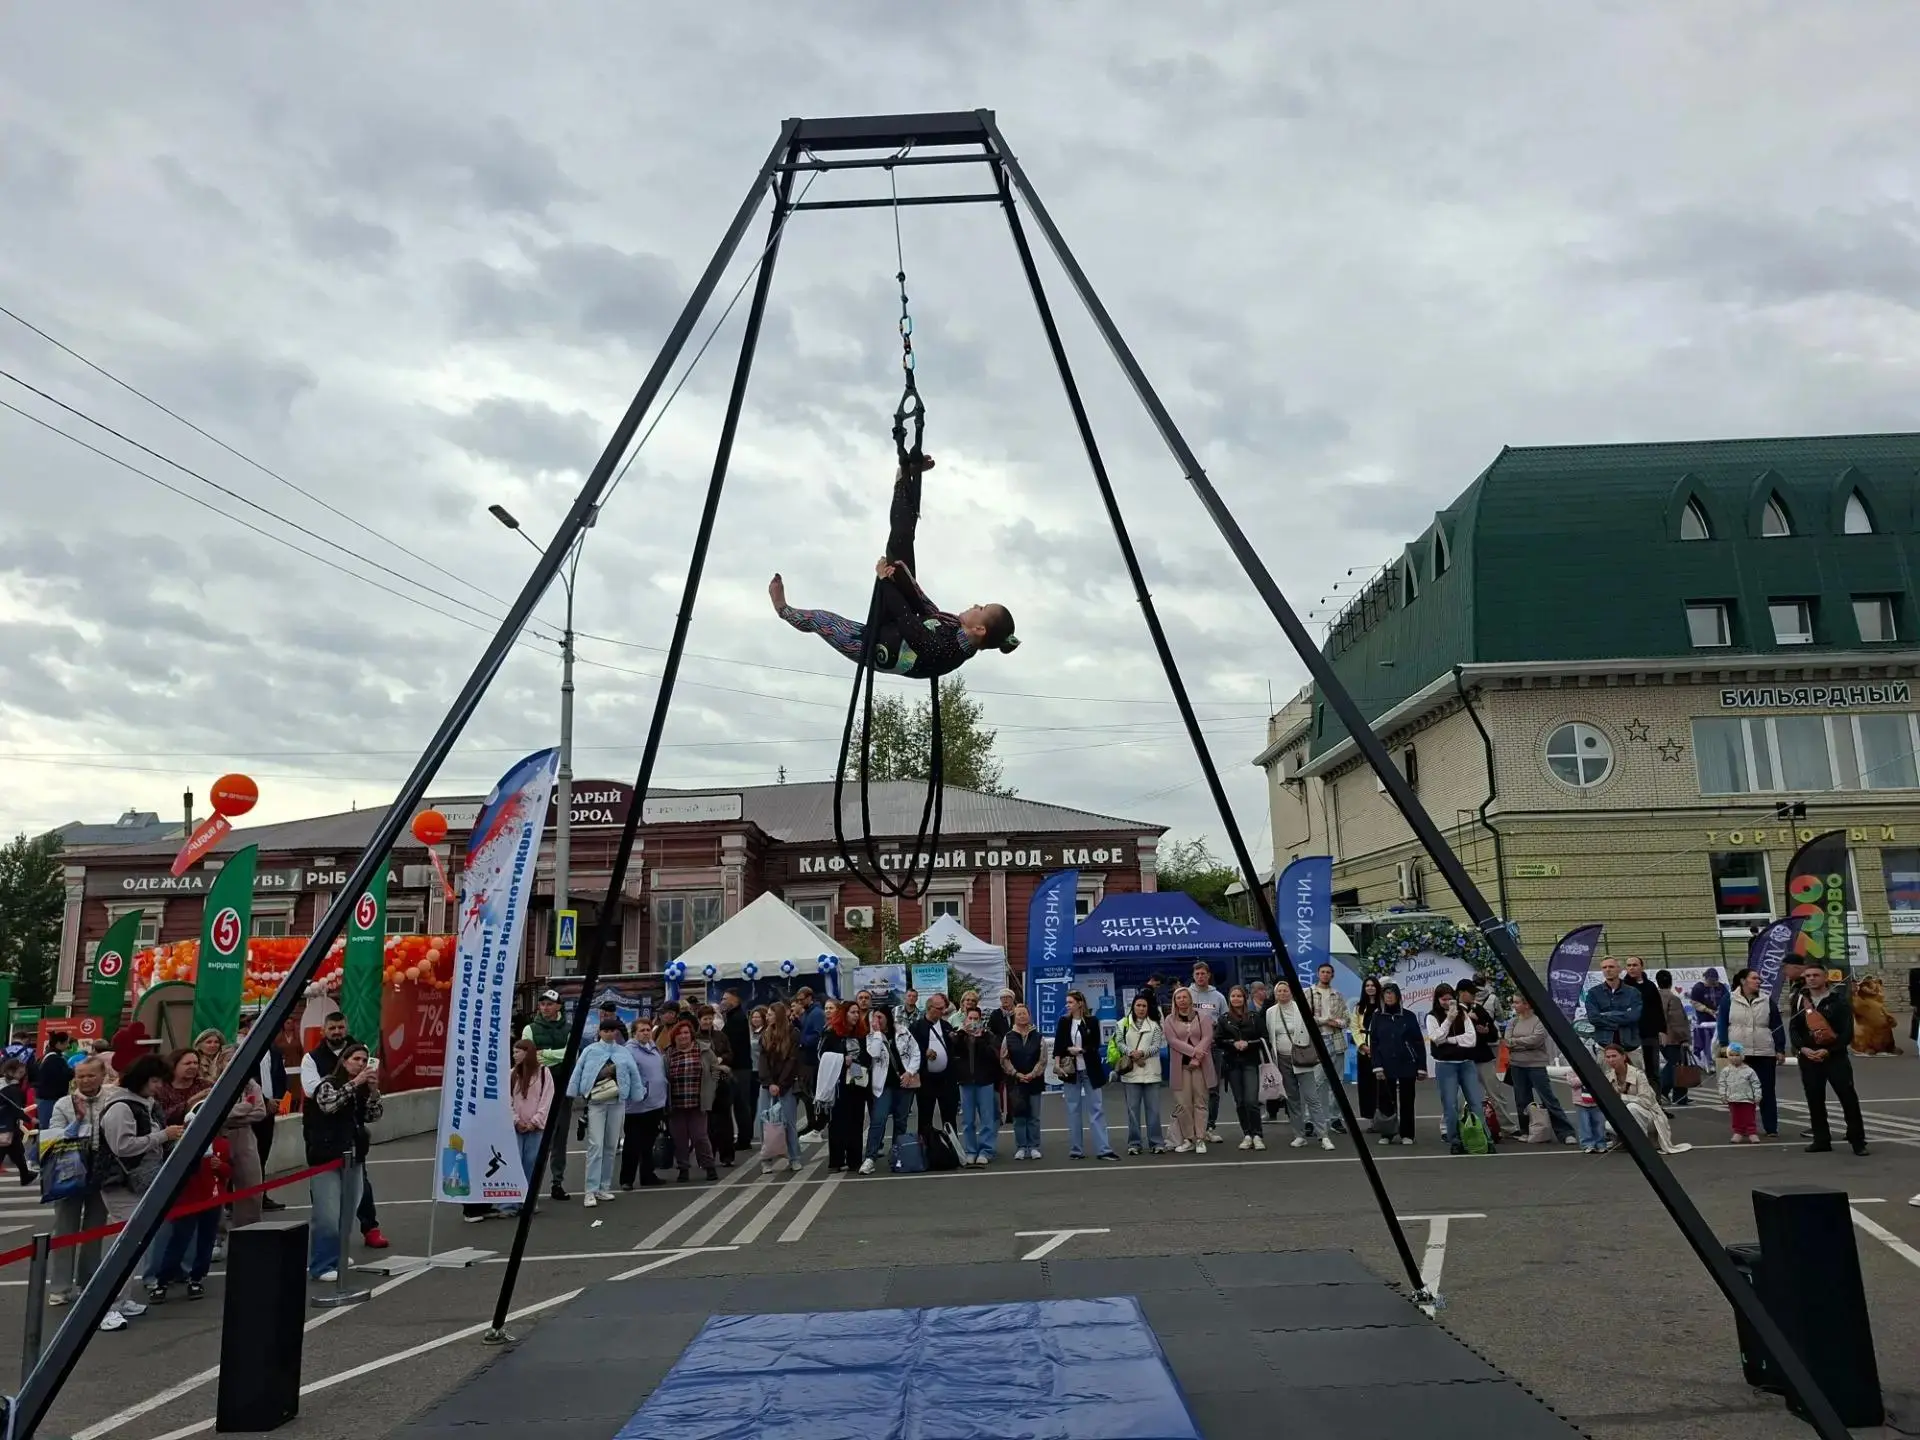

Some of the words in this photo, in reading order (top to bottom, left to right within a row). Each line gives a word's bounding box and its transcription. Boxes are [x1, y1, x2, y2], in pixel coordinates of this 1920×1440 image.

[1720, 680, 1911, 707] БИЛЬЯРДНЫЙ
[552, 788, 622, 804] САРЫЙ
[570, 809, 613, 822] ОРОД
[1706, 823, 1895, 844] ТОРГОЫЙ
[799, 856, 858, 873] КАФЕ
[867, 850, 966, 870] СТАРЫЙ
[974, 849, 1053, 867] ГОРОД»
[1062, 848, 1123, 866] КАФЕ
[1550, 865, 1557, 875] 6
[123, 877, 203, 890] ОДЕЖДА
[500, 820, 534, 945] наркотиков!
[360, 896, 373, 923] 5
[1101, 916, 1200, 928] ЛЕГЕНДА
[1827, 873, 1846, 960] МИРОВО
[220, 911, 236, 946] 5
[1086, 946, 1109, 954] вода
[1110, 943, 1140, 952] Алтая
[1142, 943, 1154, 951] из
[1155, 941, 1220, 952] артезианских
[1222, 940, 1272, 950] источнико
[103, 954, 117, 973] 5
[492, 950, 507, 988] без
[457, 955, 473, 1035] победе!
[417, 1004, 444, 1037] 7%
[467, 998, 484, 1100] выбираю
[476, 929, 494, 994] спорт!
[483, 990, 502, 1100] Побеждай
